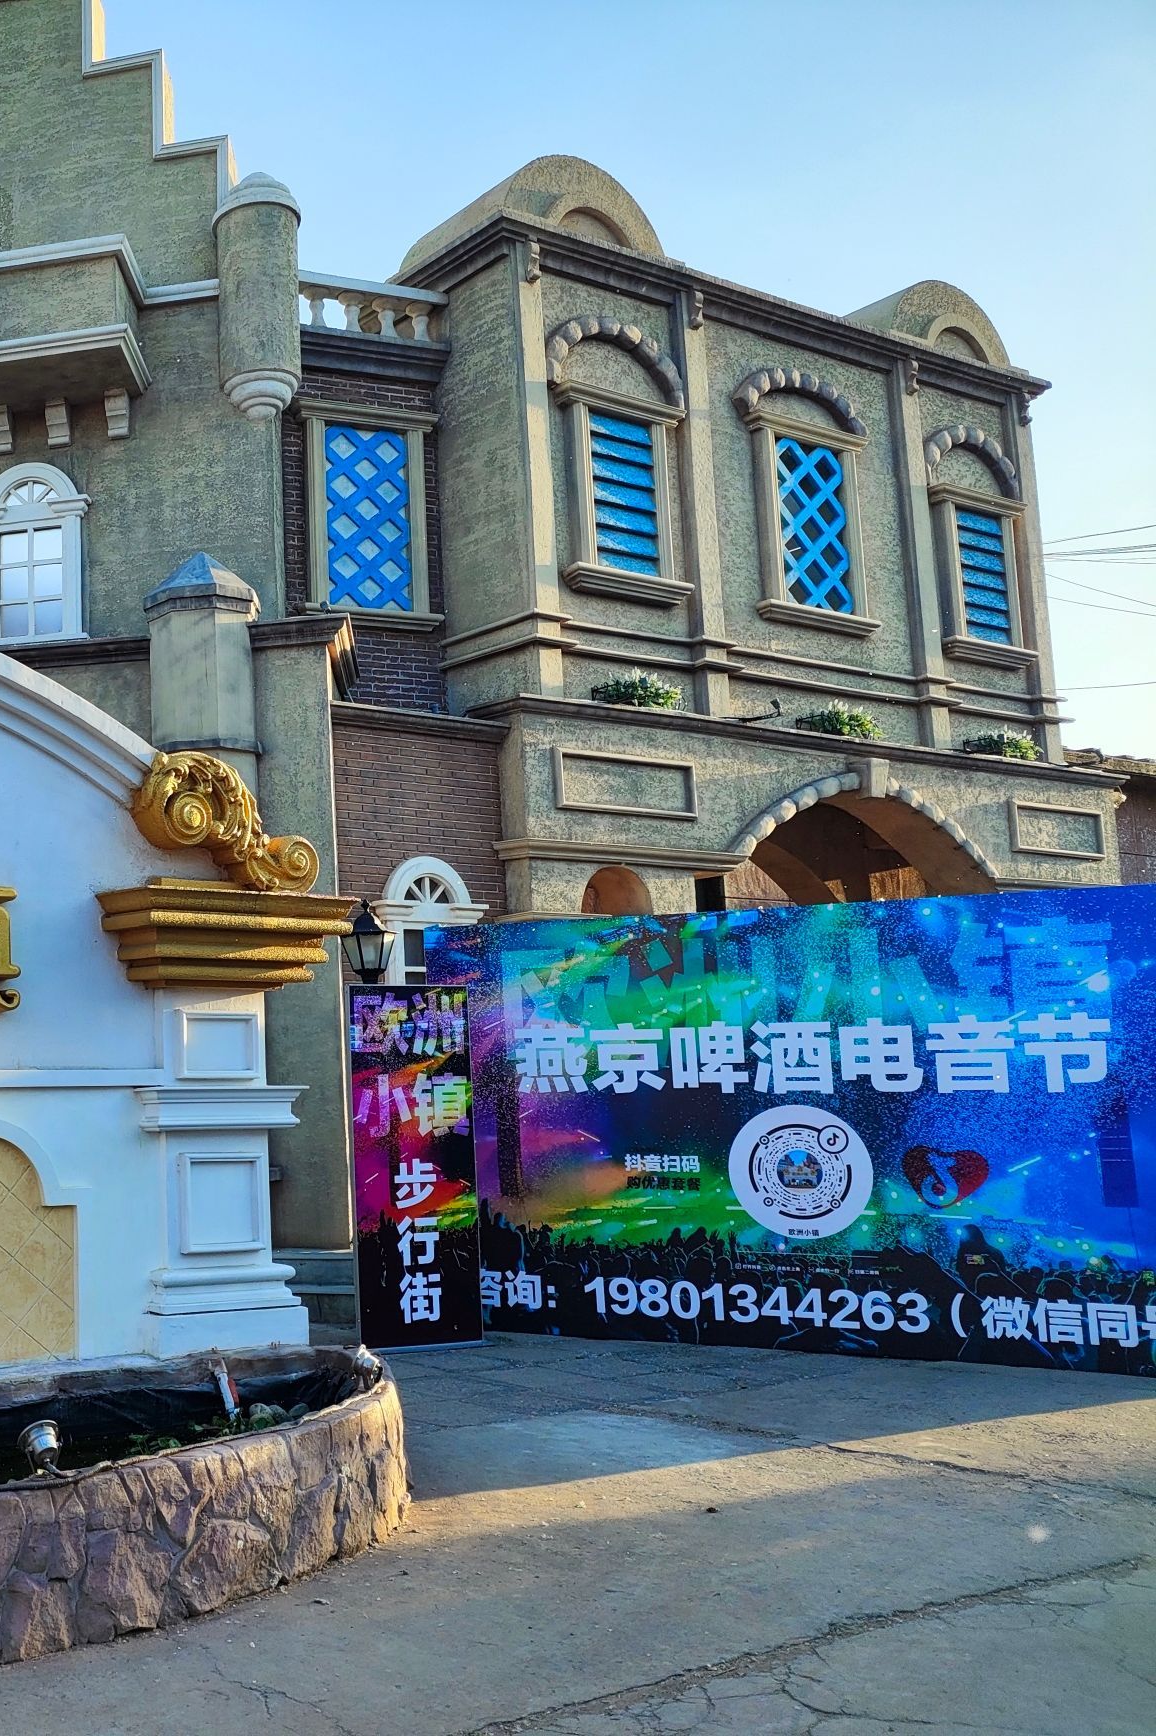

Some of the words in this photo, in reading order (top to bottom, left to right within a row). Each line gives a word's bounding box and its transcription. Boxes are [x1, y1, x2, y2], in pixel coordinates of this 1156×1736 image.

[350, 991, 466, 1056] 欧洲
[514, 1012, 1112, 1095] 燕京啤酒电音节
[356, 1072, 470, 1138] 小镇
[624, 1153, 701, 1173] 抖音扫码
[626, 1175, 701, 1191] 购优惠套餐
[394, 1157, 443, 1325] 步行街
[787, 1228, 820, 1237] 欧洲小镇
